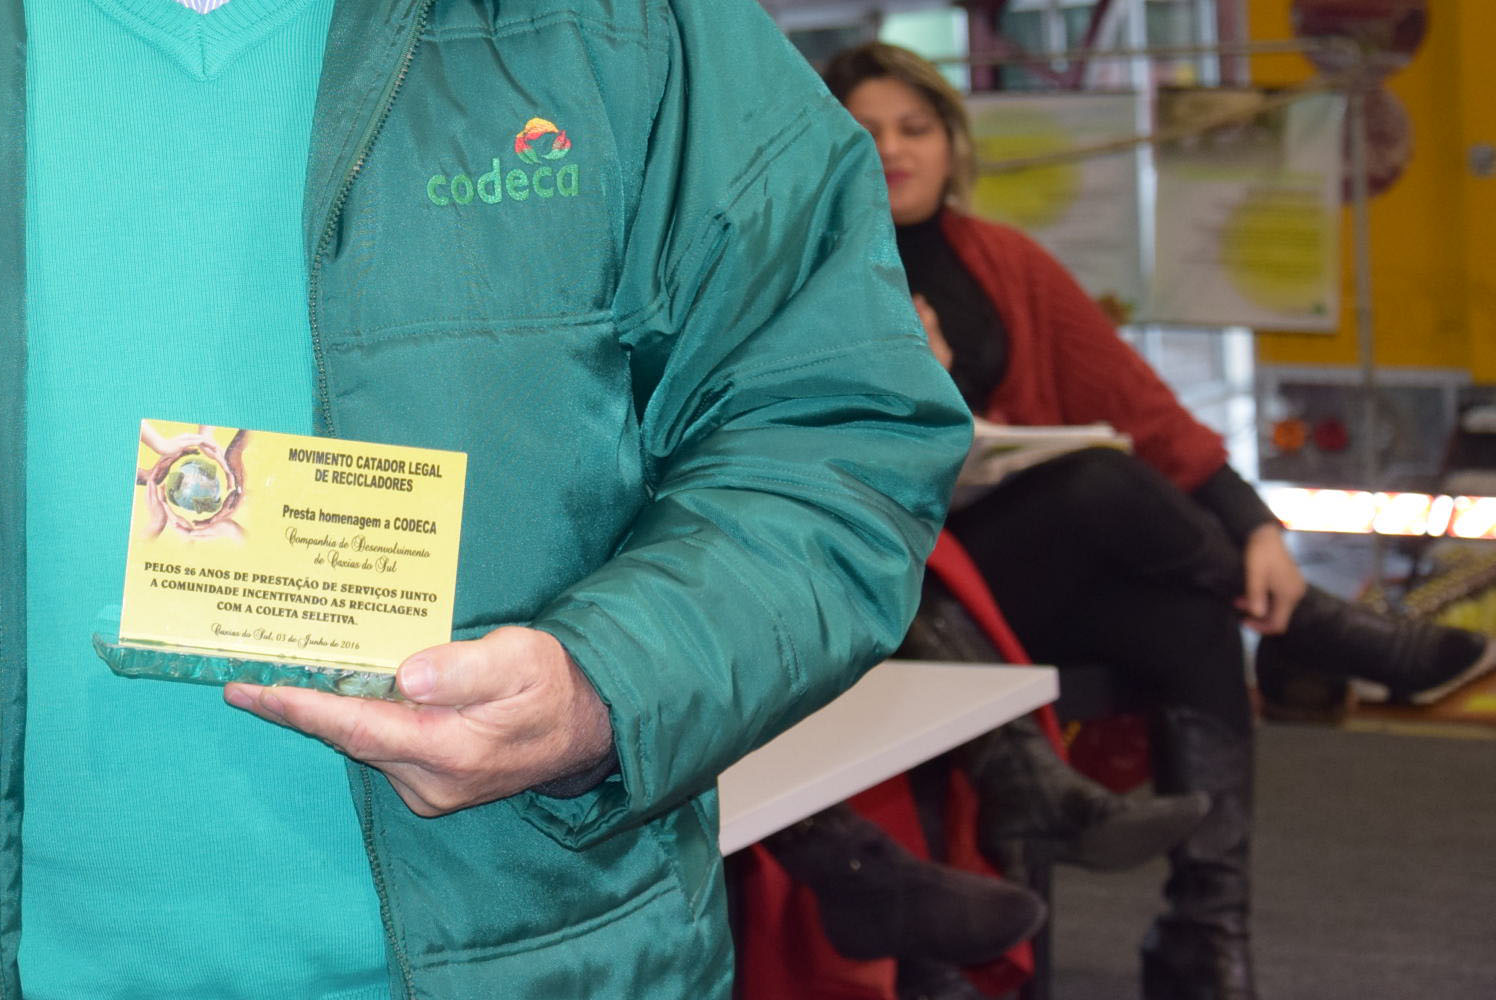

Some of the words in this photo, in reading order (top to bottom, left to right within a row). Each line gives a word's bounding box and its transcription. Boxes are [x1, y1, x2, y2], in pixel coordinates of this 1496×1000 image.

[426, 157, 579, 206] codeca
[289, 448, 353, 468] MOVIMENTO
[356, 455, 405, 473] CATADOR
[408, 461, 442, 478] LEGAL
[314, 468, 328, 483] DE
[332, 470, 413, 492] RECICLADORES
[282, 504, 316, 521] Presta
[319, 508, 381, 530] homenagem
[384, 518, 390, 530] a
[393, 517, 437, 534] CODECA
[285, 526, 337, 550] Companhia
[338, 536, 349, 549] de
[351, 534, 430, 558] Desenvolvimento
[314, 553, 324, 565] de
[327, 549, 360, 569] Caxias
[362, 558, 373, 570] do
[375, 555, 398, 574] Sul
[144, 561, 181, 574] PELOS
[184, 567, 196, 576] 26
[199, 568, 230, 580] ANOS
[233, 572, 249, 582] DE
[252, 573, 319, 590] PRESTAÇÃO
[321, 581, 338, 592] DE
[340, 583, 397, 599] SERVIÇOS
[400, 590, 437, 603] JUNTO
[150, 578, 158, 587] A
[161, 579, 239, 597] COMUNIDADE
[242, 587, 328, 606] INCENTIVANDO
[330, 598, 346, 608] AS
[349, 600, 428, 617] RECICLAGENS
[216, 601, 242, 613] COM
[244, 604, 253, 613] A
[255, 606, 298, 618] COLETA
[301, 610, 358, 625] SELETIVA.
[241, 629, 251, 638] do
[287, 634, 297, 643] de
[297, 633, 328, 649] Junho
[329, 639, 339, 648] de
[341, 641, 360, 650] 2016
